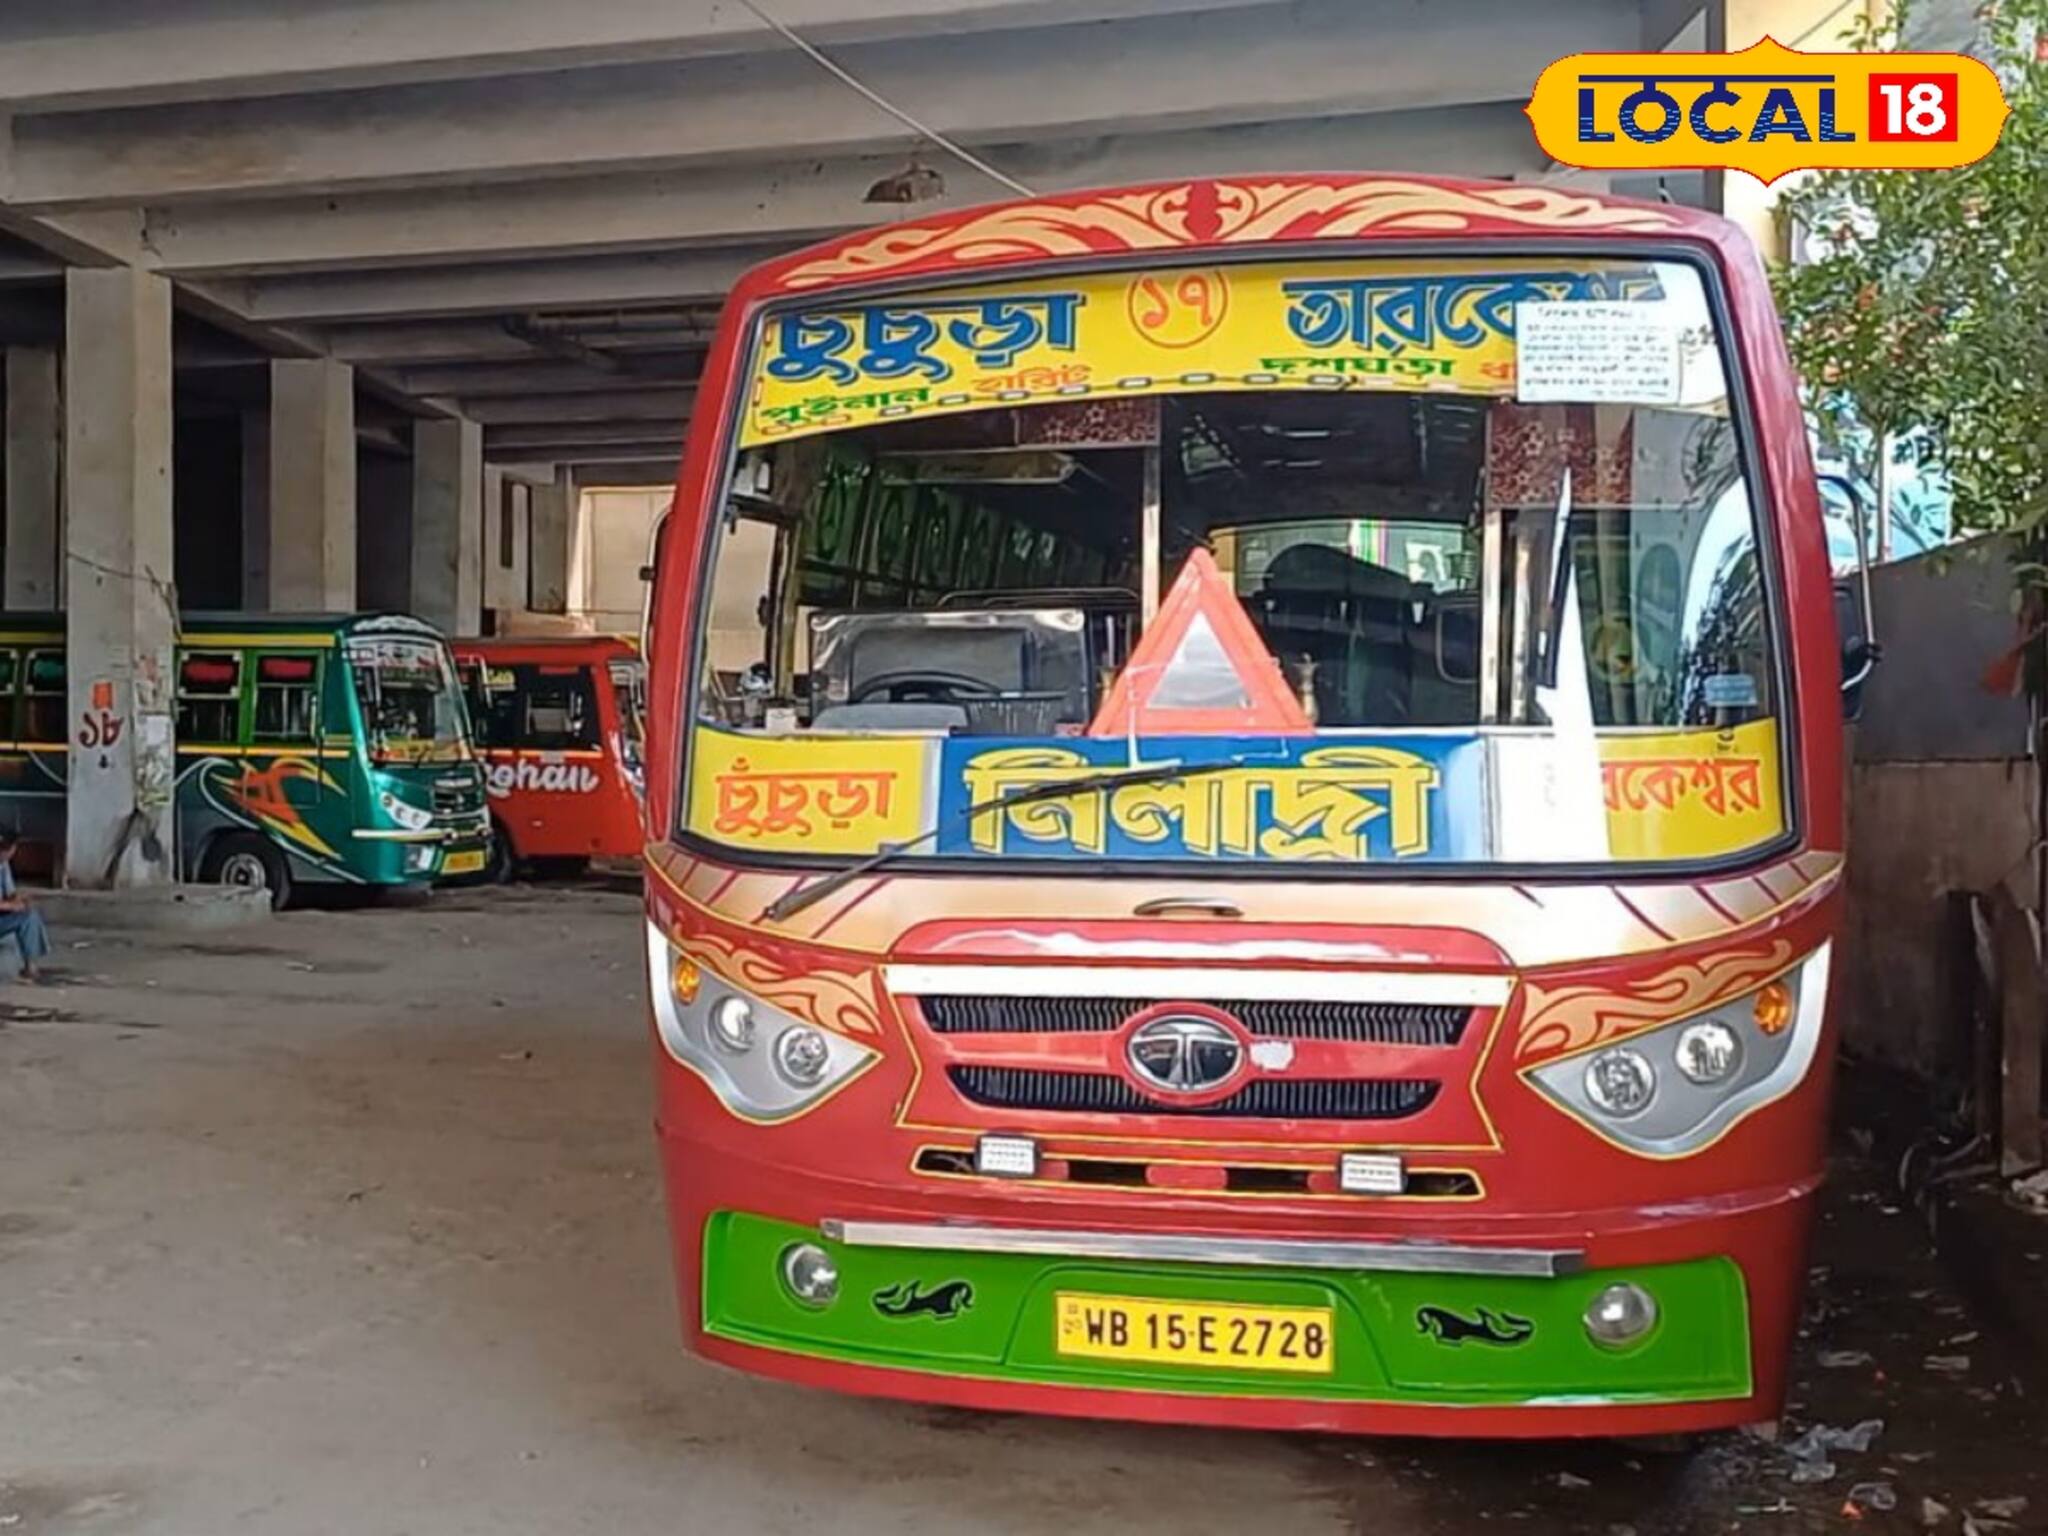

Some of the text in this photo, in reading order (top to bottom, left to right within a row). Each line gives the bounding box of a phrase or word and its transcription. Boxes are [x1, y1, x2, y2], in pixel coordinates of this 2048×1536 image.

[1139, 268, 1212, 328] ১৭
[714, 756, 898, 838] চুঁচুড়া
[1085, 1307, 1129, 1348] WB
[1229, 1317, 1325, 1360] 2728
